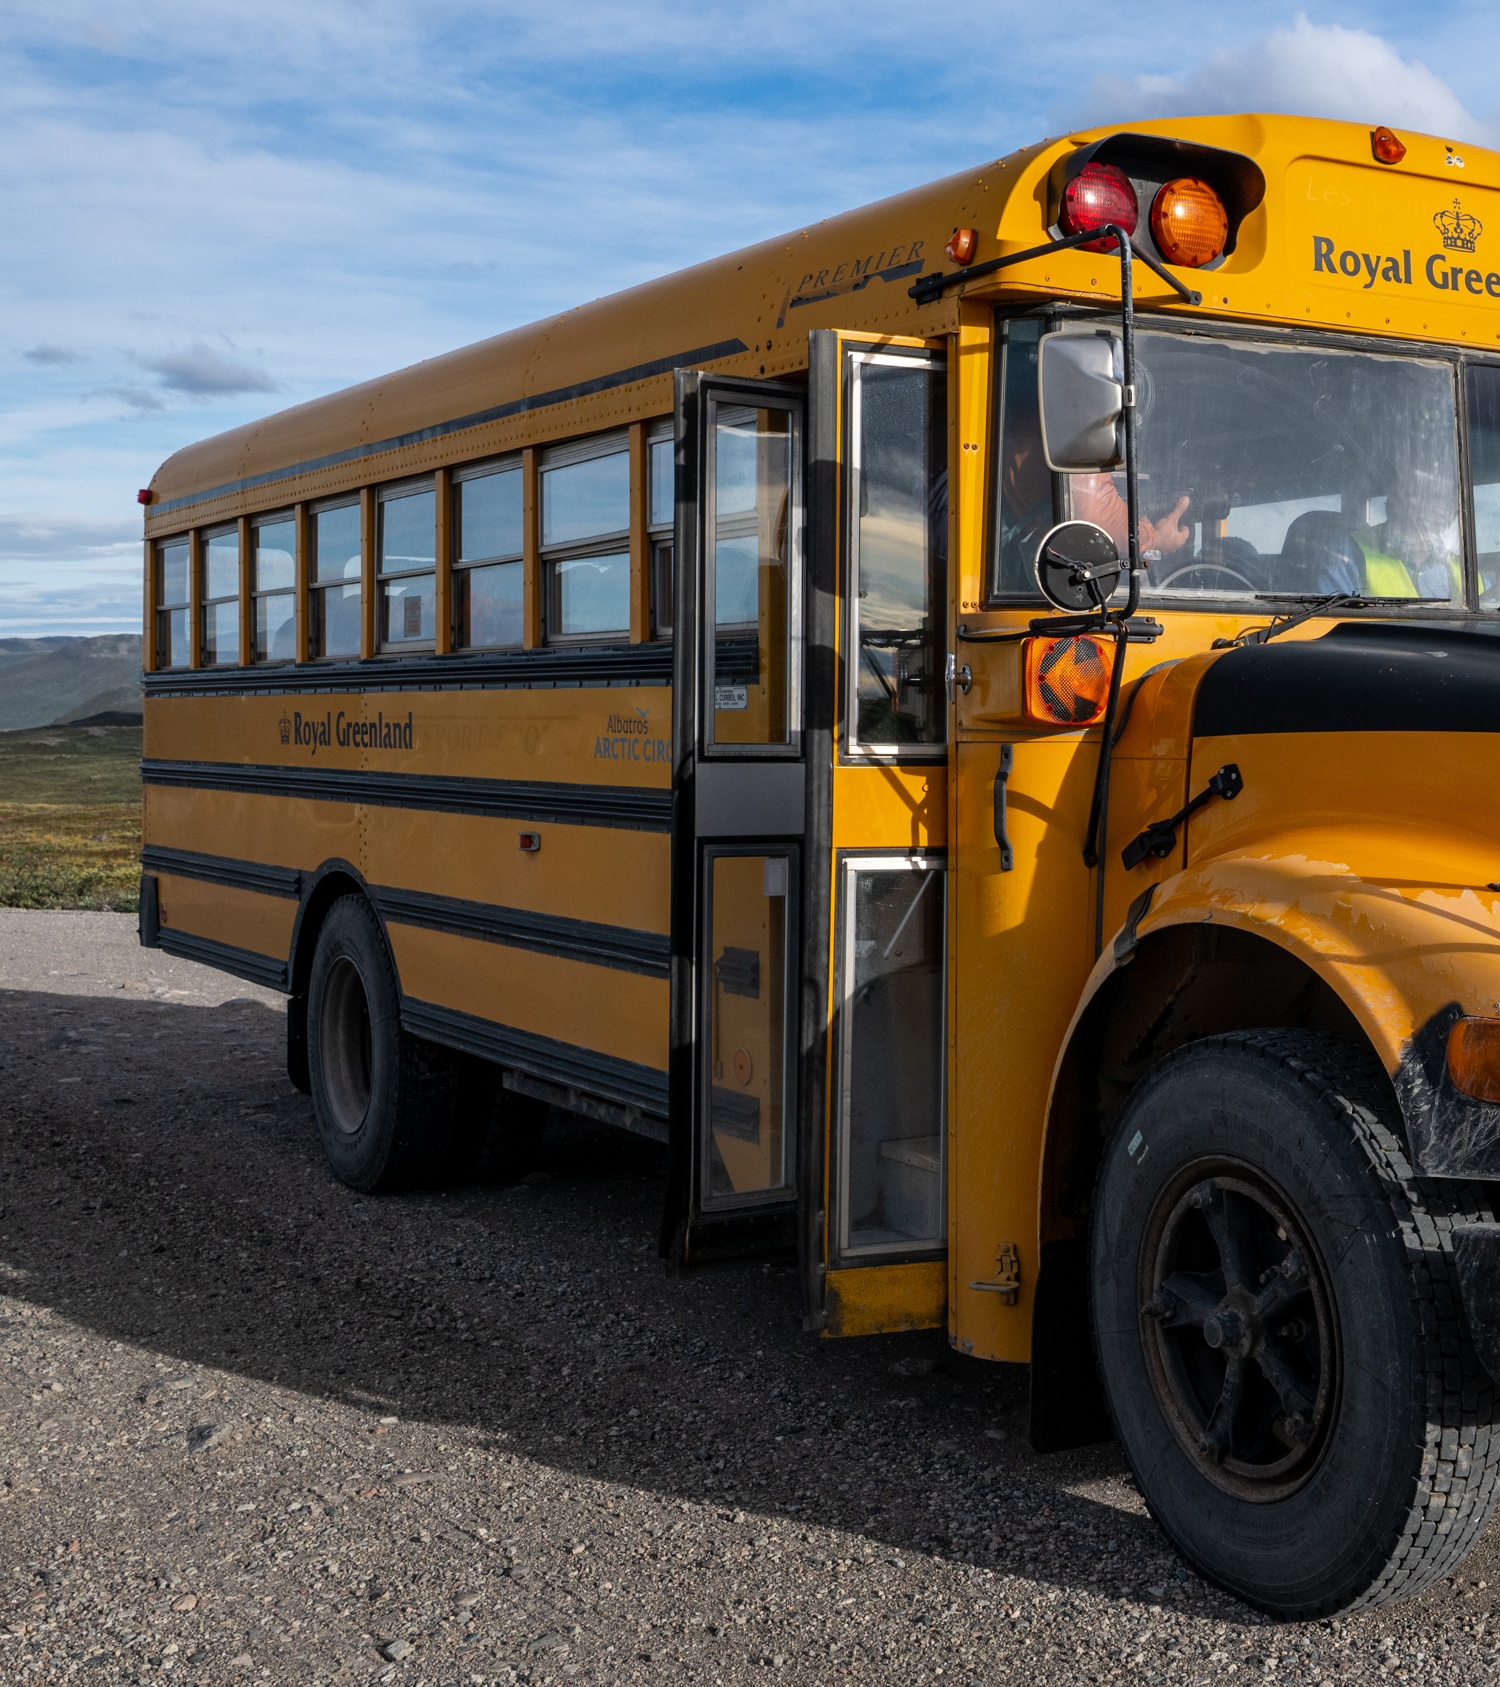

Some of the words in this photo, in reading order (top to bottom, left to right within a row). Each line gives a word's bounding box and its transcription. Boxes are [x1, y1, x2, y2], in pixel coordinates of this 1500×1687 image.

[797, 240, 925, 293] PREMIER
[1312, 235, 1413, 289] Royal
[293, 711, 331, 756] Royal
[336, 710, 413, 749] Greenland
[607, 714, 648, 735] Albatros
[594, 736, 640, 761] ARCTIC
